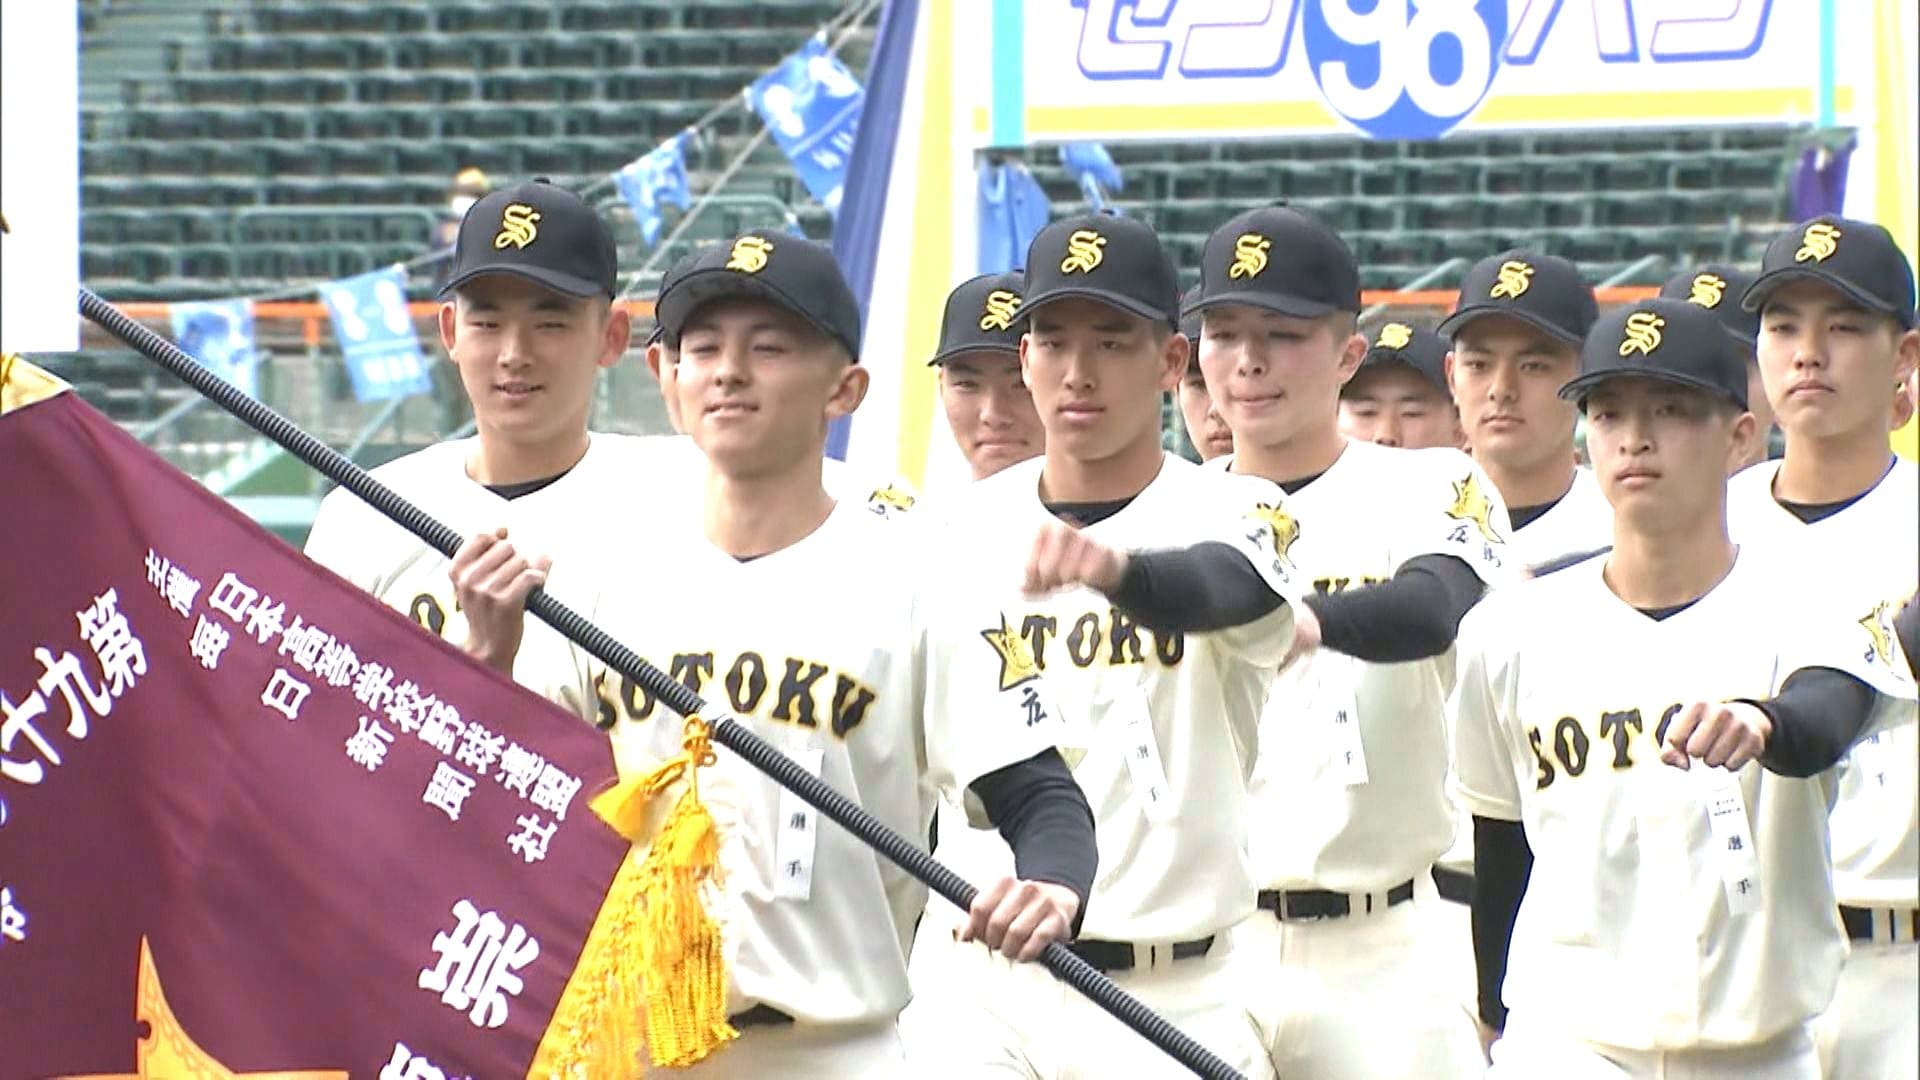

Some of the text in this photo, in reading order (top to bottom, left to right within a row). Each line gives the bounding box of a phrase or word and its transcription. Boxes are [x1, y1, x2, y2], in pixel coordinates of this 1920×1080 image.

[495, 203, 541, 250] S
[1796, 224, 1842, 265] S
[725, 235, 774, 273] S
[1061, 229, 1107, 275] S
[1230, 233, 1272, 279] S
[1490, 260, 1535, 299] S
[1688, 272, 1726, 309] S
[980, 289, 1022, 331] S
[1619, 311, 1665, 356] S
